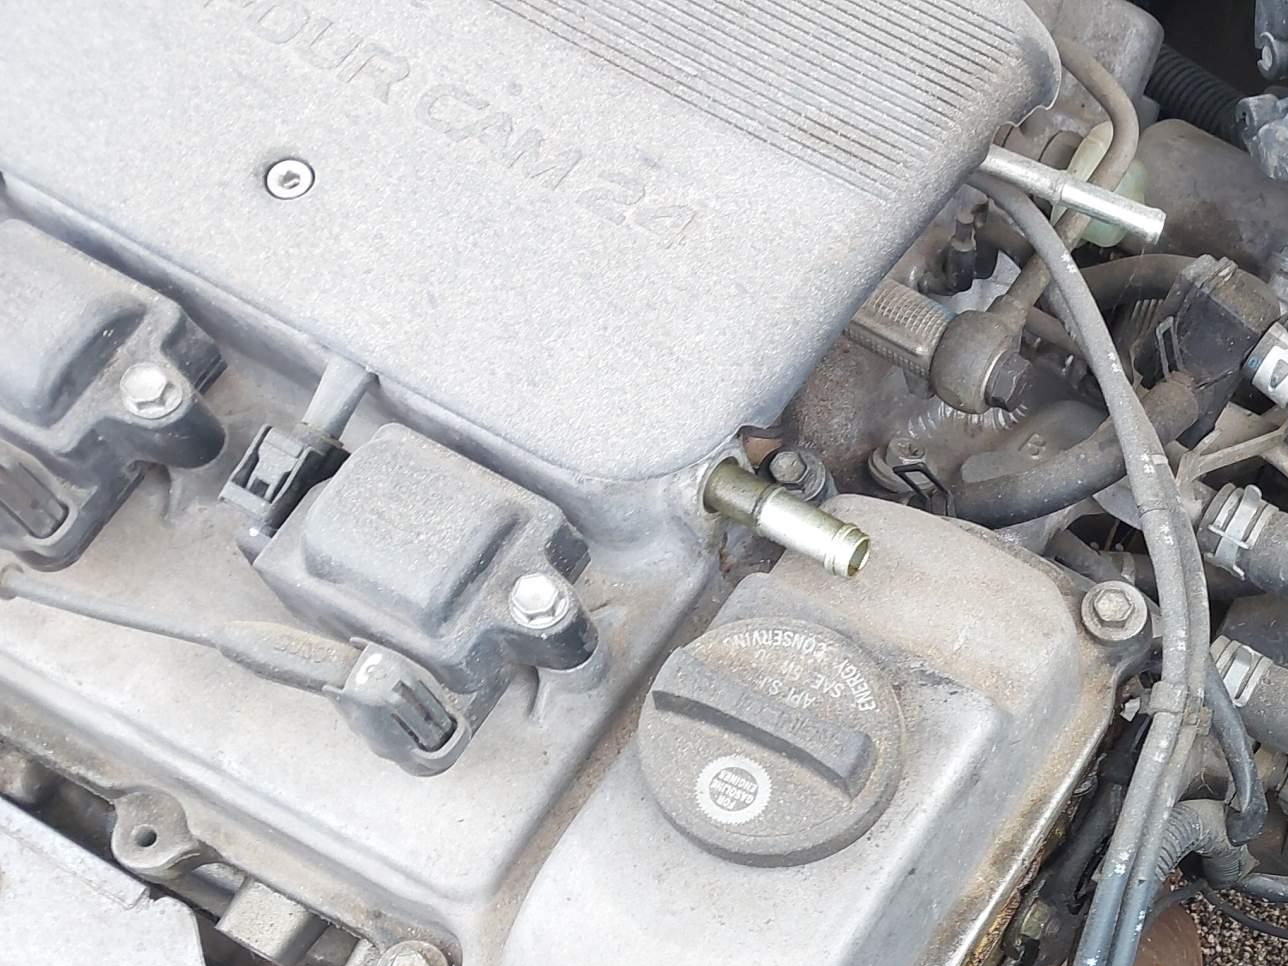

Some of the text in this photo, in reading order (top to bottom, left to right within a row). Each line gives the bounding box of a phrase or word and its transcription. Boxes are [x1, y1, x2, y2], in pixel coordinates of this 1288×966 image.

[206, 0, 410, 105] OUR
[415, 82, 583, 190] CAM
[784, 687, 817, 710] API
[810, 673, 846, 699] SAE
[832, 658, 878, 713] ENERGY
